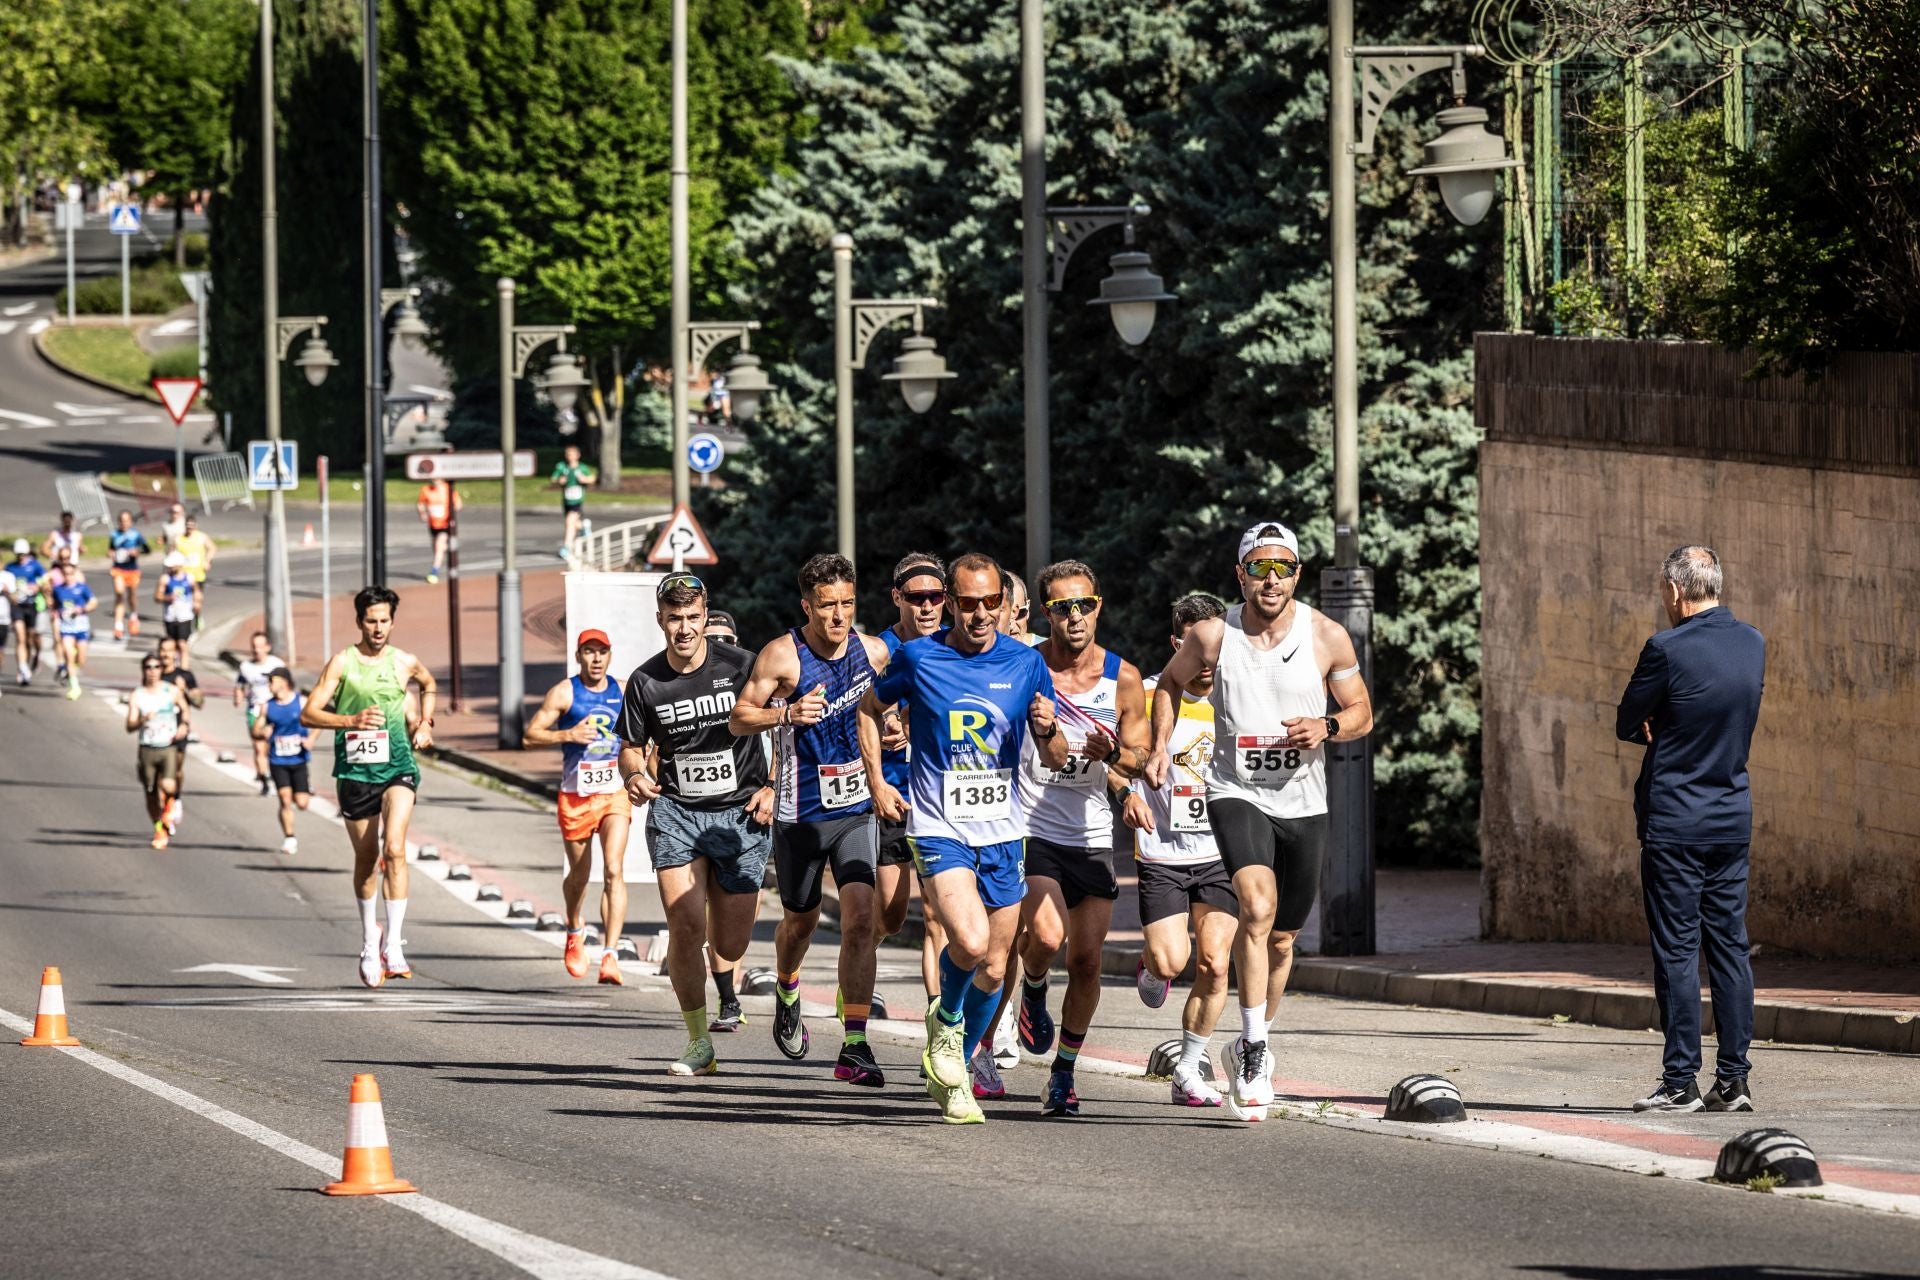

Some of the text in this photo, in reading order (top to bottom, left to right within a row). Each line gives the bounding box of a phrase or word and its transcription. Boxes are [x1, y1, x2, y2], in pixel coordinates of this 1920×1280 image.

[356, 741, 378, 754] 45
[951, 743, 973, 753] CLUB
[1244, 748, 1301, 771] 558
[583, 769, 613, 784] 333
[681, 763, 732, 783] 1238
[956, 773, 994, 781] CARRERA
[843, 789, 864, 800] JAVIER
[950, 784, 1008, 806] 1383
